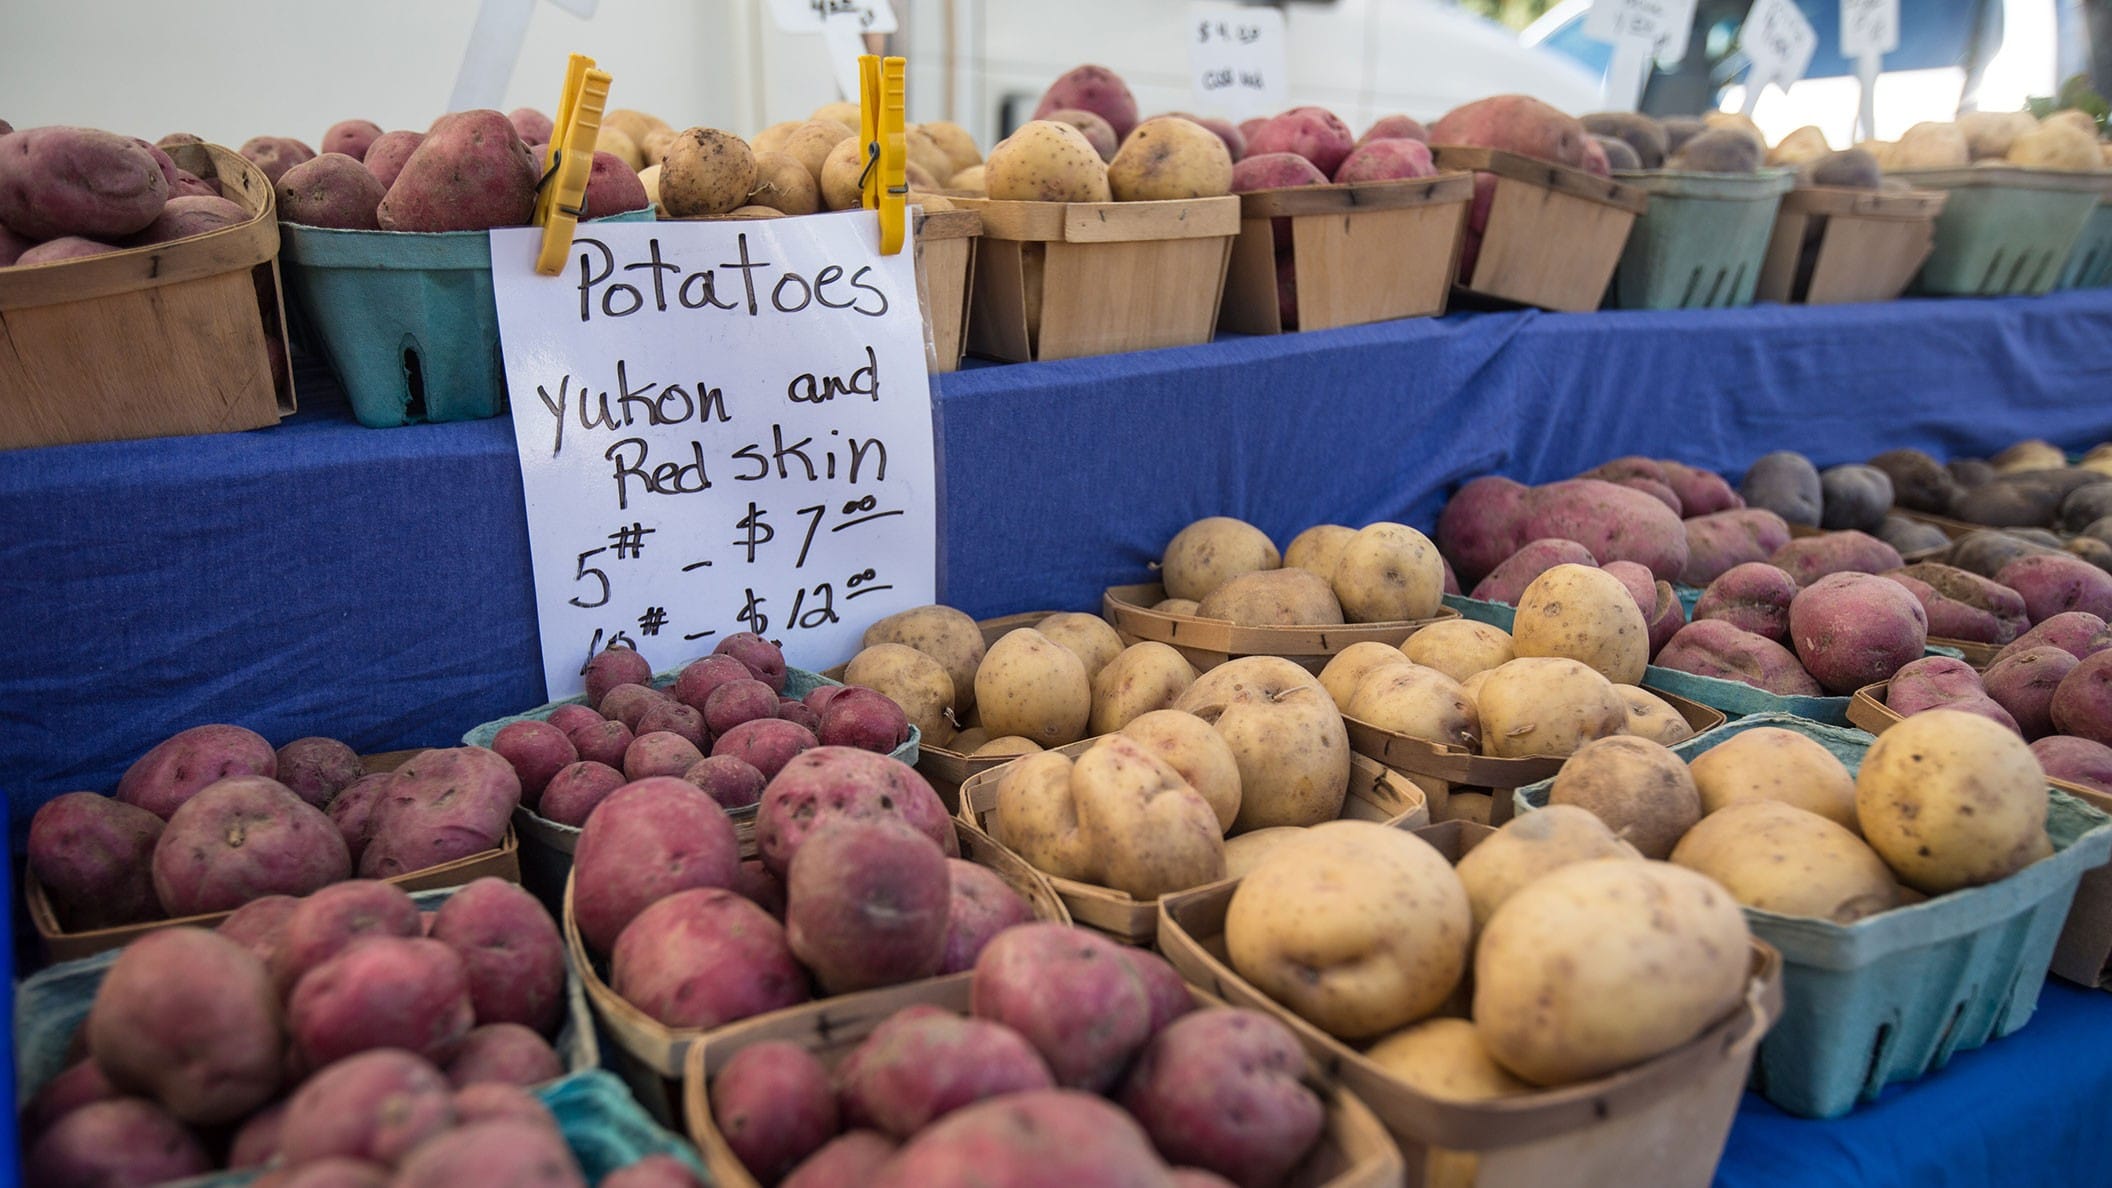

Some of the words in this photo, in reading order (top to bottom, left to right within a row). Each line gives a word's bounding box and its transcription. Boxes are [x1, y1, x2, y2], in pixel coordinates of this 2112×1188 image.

[572, 231, 889, 322] Potatoes
[788, 346, 881, 404] and
[604, 437, 713, 510] Red
[731, 423, 888, 485] skin
